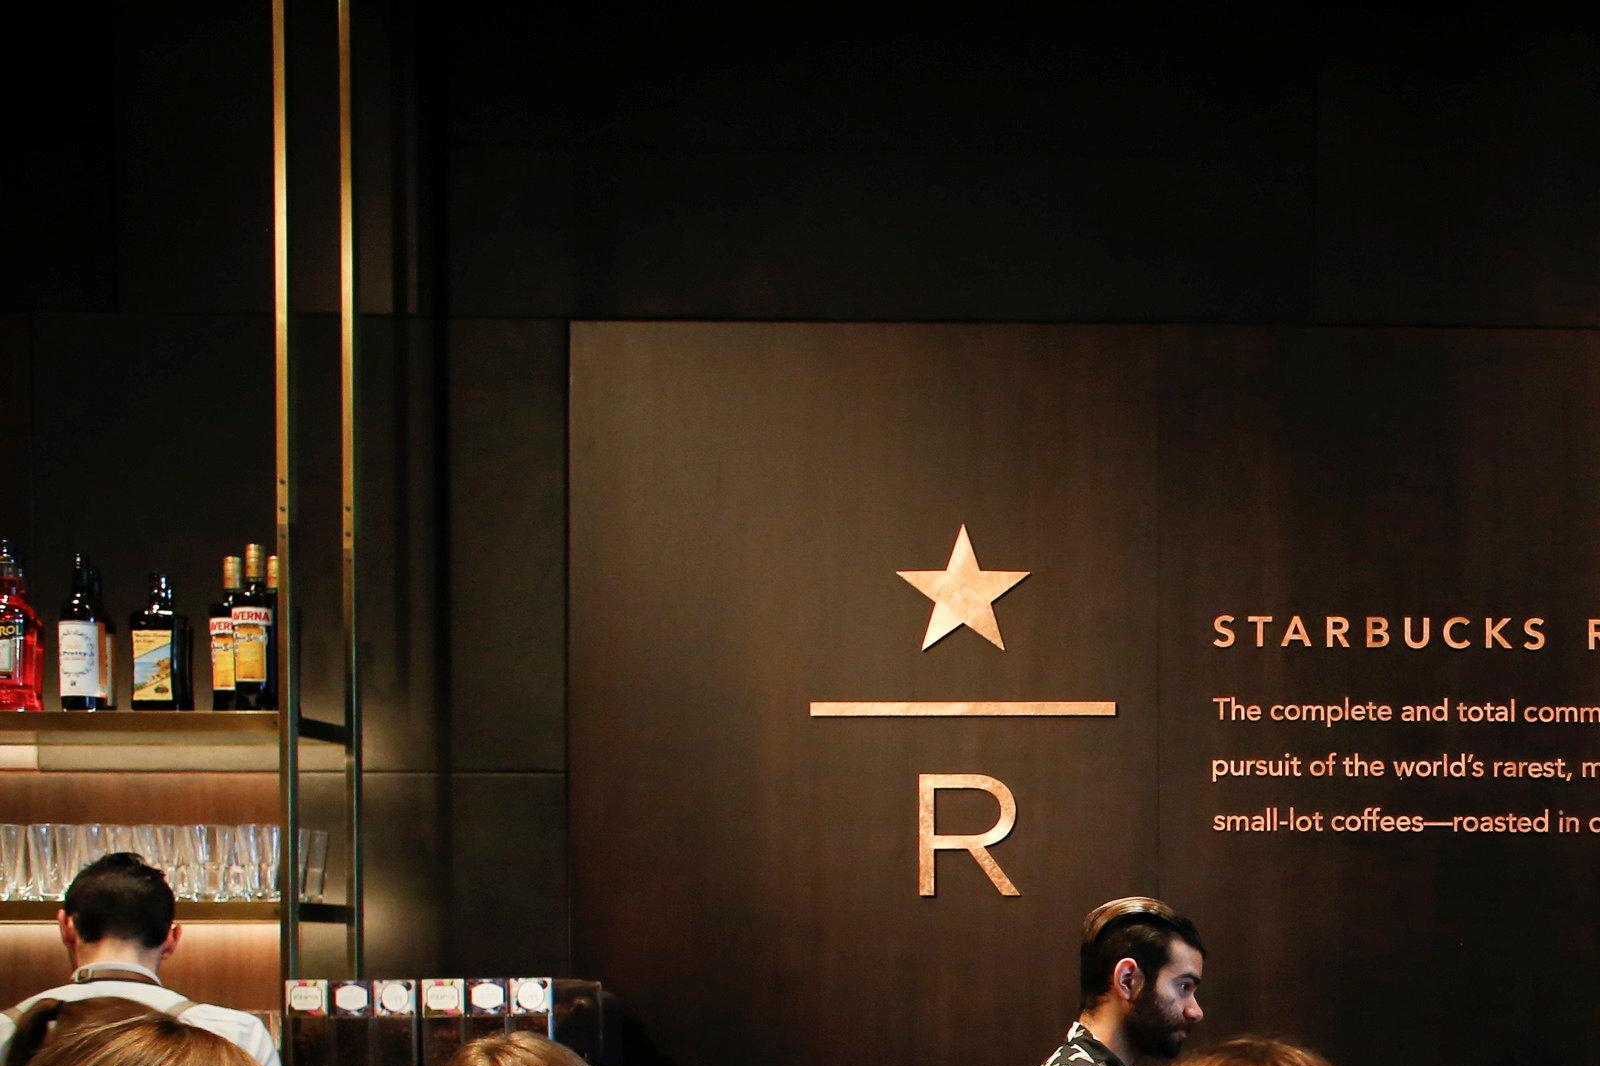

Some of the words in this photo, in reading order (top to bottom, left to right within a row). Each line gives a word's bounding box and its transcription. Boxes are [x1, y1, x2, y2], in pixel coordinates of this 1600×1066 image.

[1212, 614, 1547, 652] STARBUCKS
[1212, 696, 1262, 722] The
[1269, 696, 1393, 728] complete
[1400, 697, 1449, 722] and
[1456, 698, 1516, 723] total
[1211, 752, 1302, 783] pursuit
[1309, 751, 1337, 777] of
[1341, 752, 1385, 777] the
[1493, 756, 1573, 782] rarest,
[915, 769, 1021, 897] R
[1212, 806, 1324, 832] small-lot
[1558, 809, 1580, 833] in
